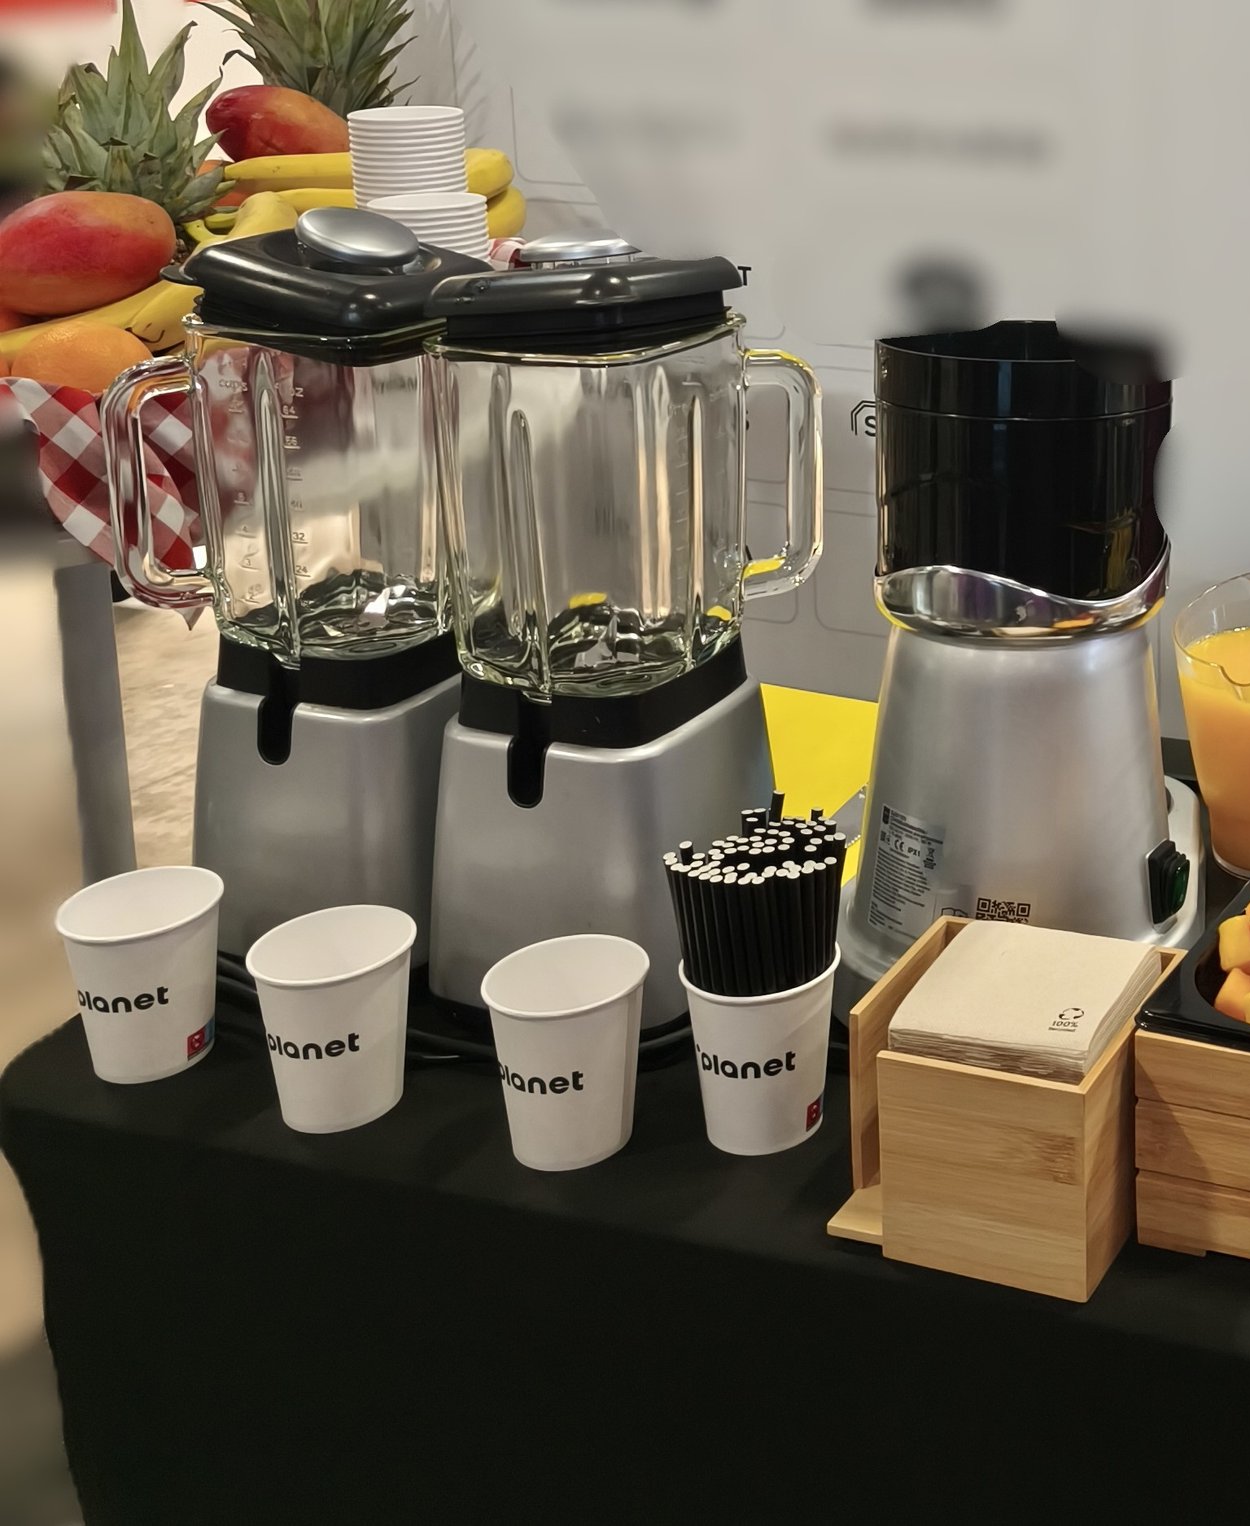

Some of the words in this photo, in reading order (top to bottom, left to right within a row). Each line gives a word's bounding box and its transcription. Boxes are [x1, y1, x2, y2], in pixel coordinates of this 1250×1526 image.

[292, 532, 305, 541] 32
[295, 565, 308, 574] 24
[268, 1032, 359, 1060] planet
